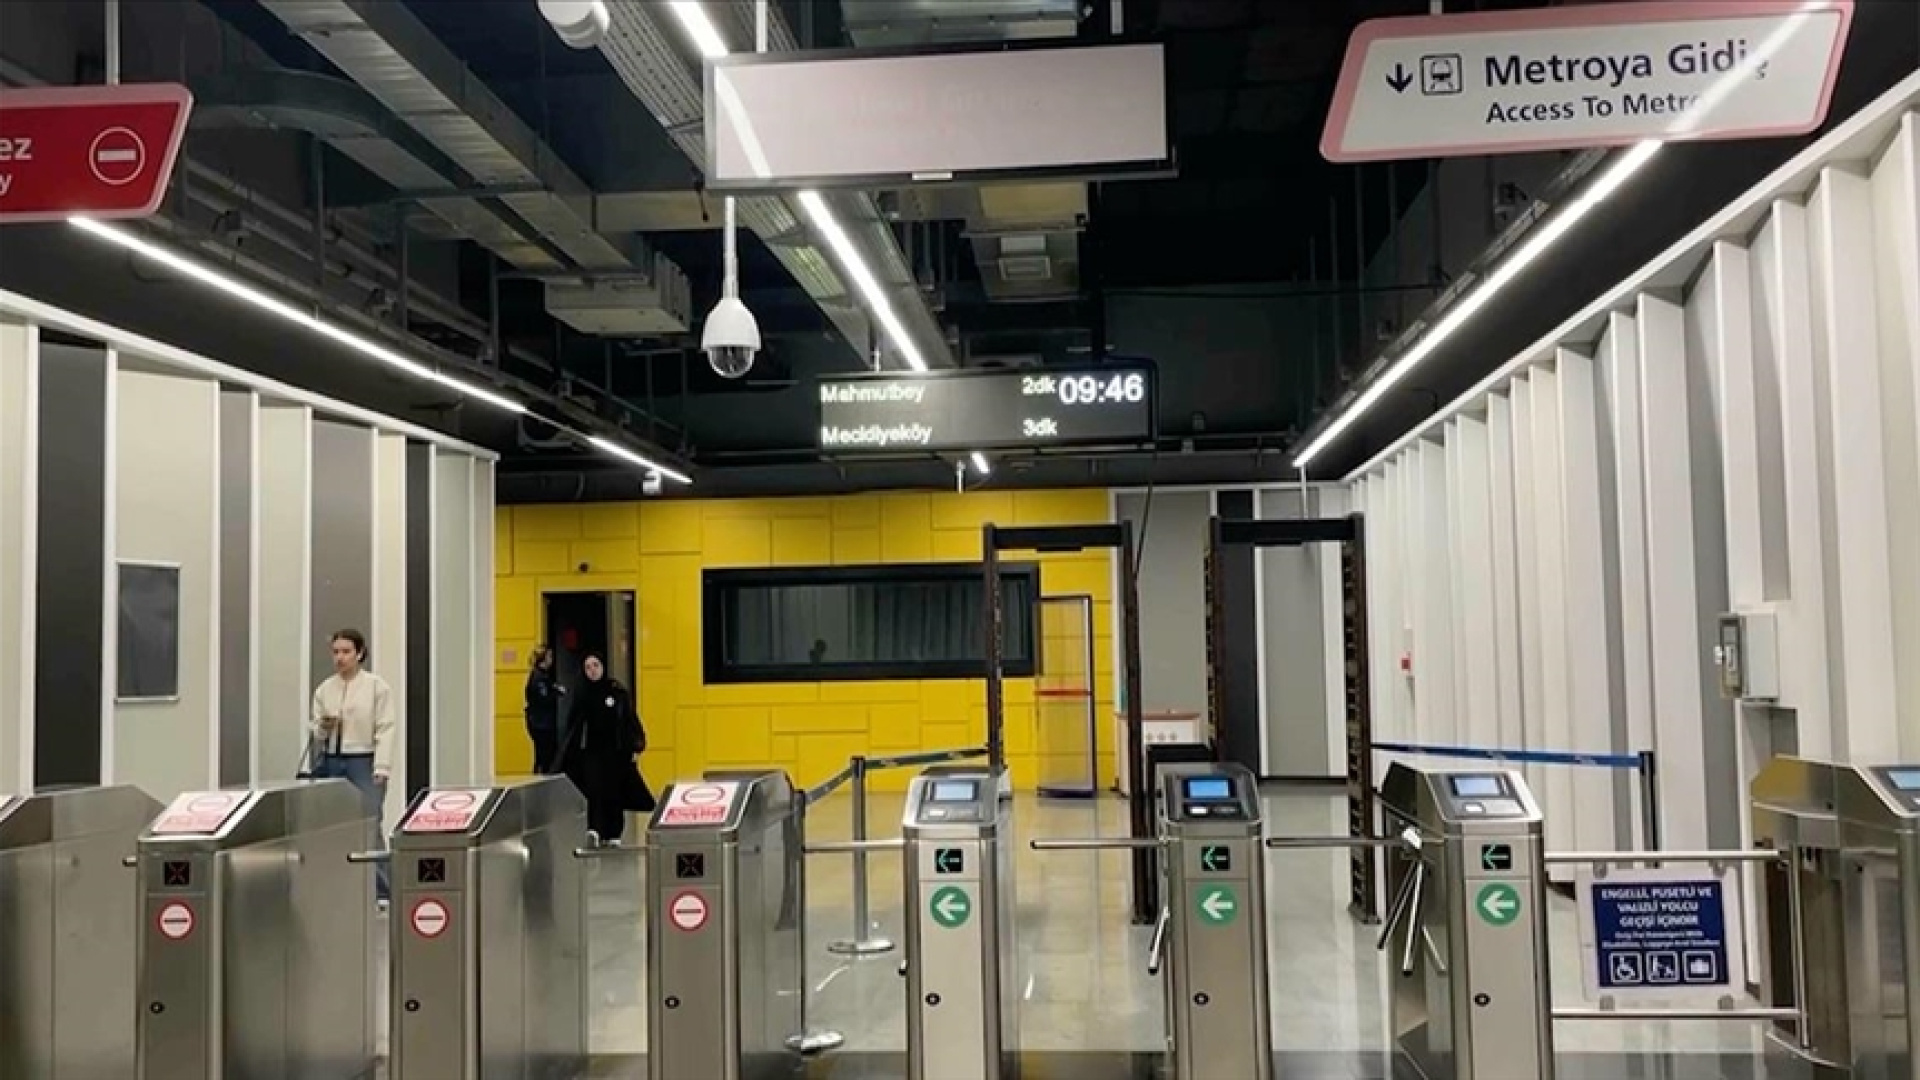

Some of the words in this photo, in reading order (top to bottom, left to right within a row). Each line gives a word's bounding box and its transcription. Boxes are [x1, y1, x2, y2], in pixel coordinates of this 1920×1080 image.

[1485, 54, 1652, 87] Metroya
[1486, 100, 1574, 123] Access
[1582, 95, 1613, 118] To
[1623, 92, 1700, 115] Metr
[820, 383, 926, 403] Mahmutbey
[1022, 375, 1055, 395] 2dk
[1059, 373, 1144, 404] 09:46
[1022, 418, 1058, 437] 3dk
